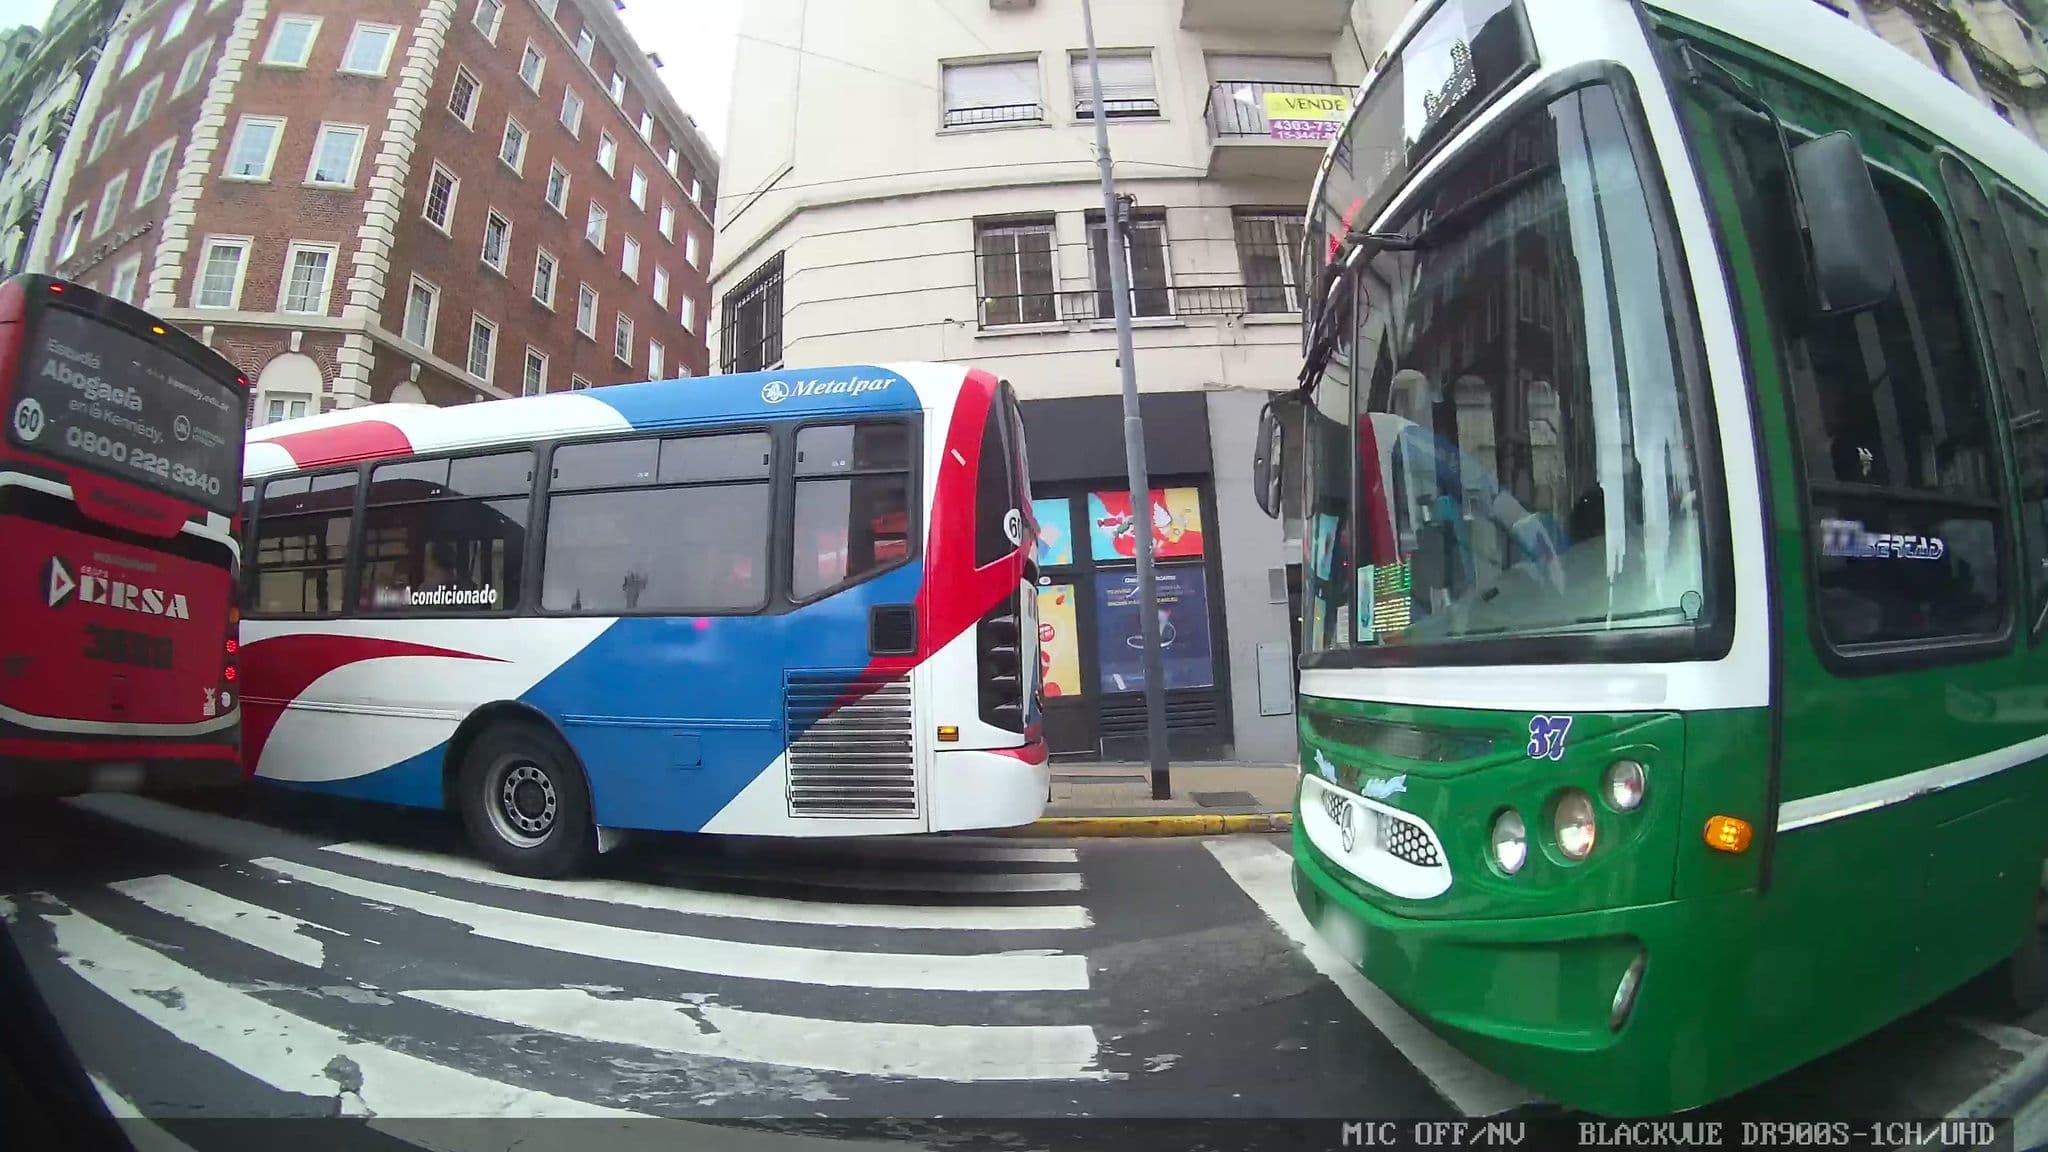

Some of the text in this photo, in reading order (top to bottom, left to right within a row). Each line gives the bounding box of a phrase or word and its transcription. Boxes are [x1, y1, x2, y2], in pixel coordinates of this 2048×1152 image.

[1284, 97, 1345, 111] VENDE
[40, 358, 143, 412] Abogacía
[790, 376, 897, 398] Metalpar
[18, 406, 39, 433] 60
[66, 426, 220, 496] 0800 222 3340
[403, 583, 498, 606] Acondicionado
[1526, 714, 1574, 762] 37
